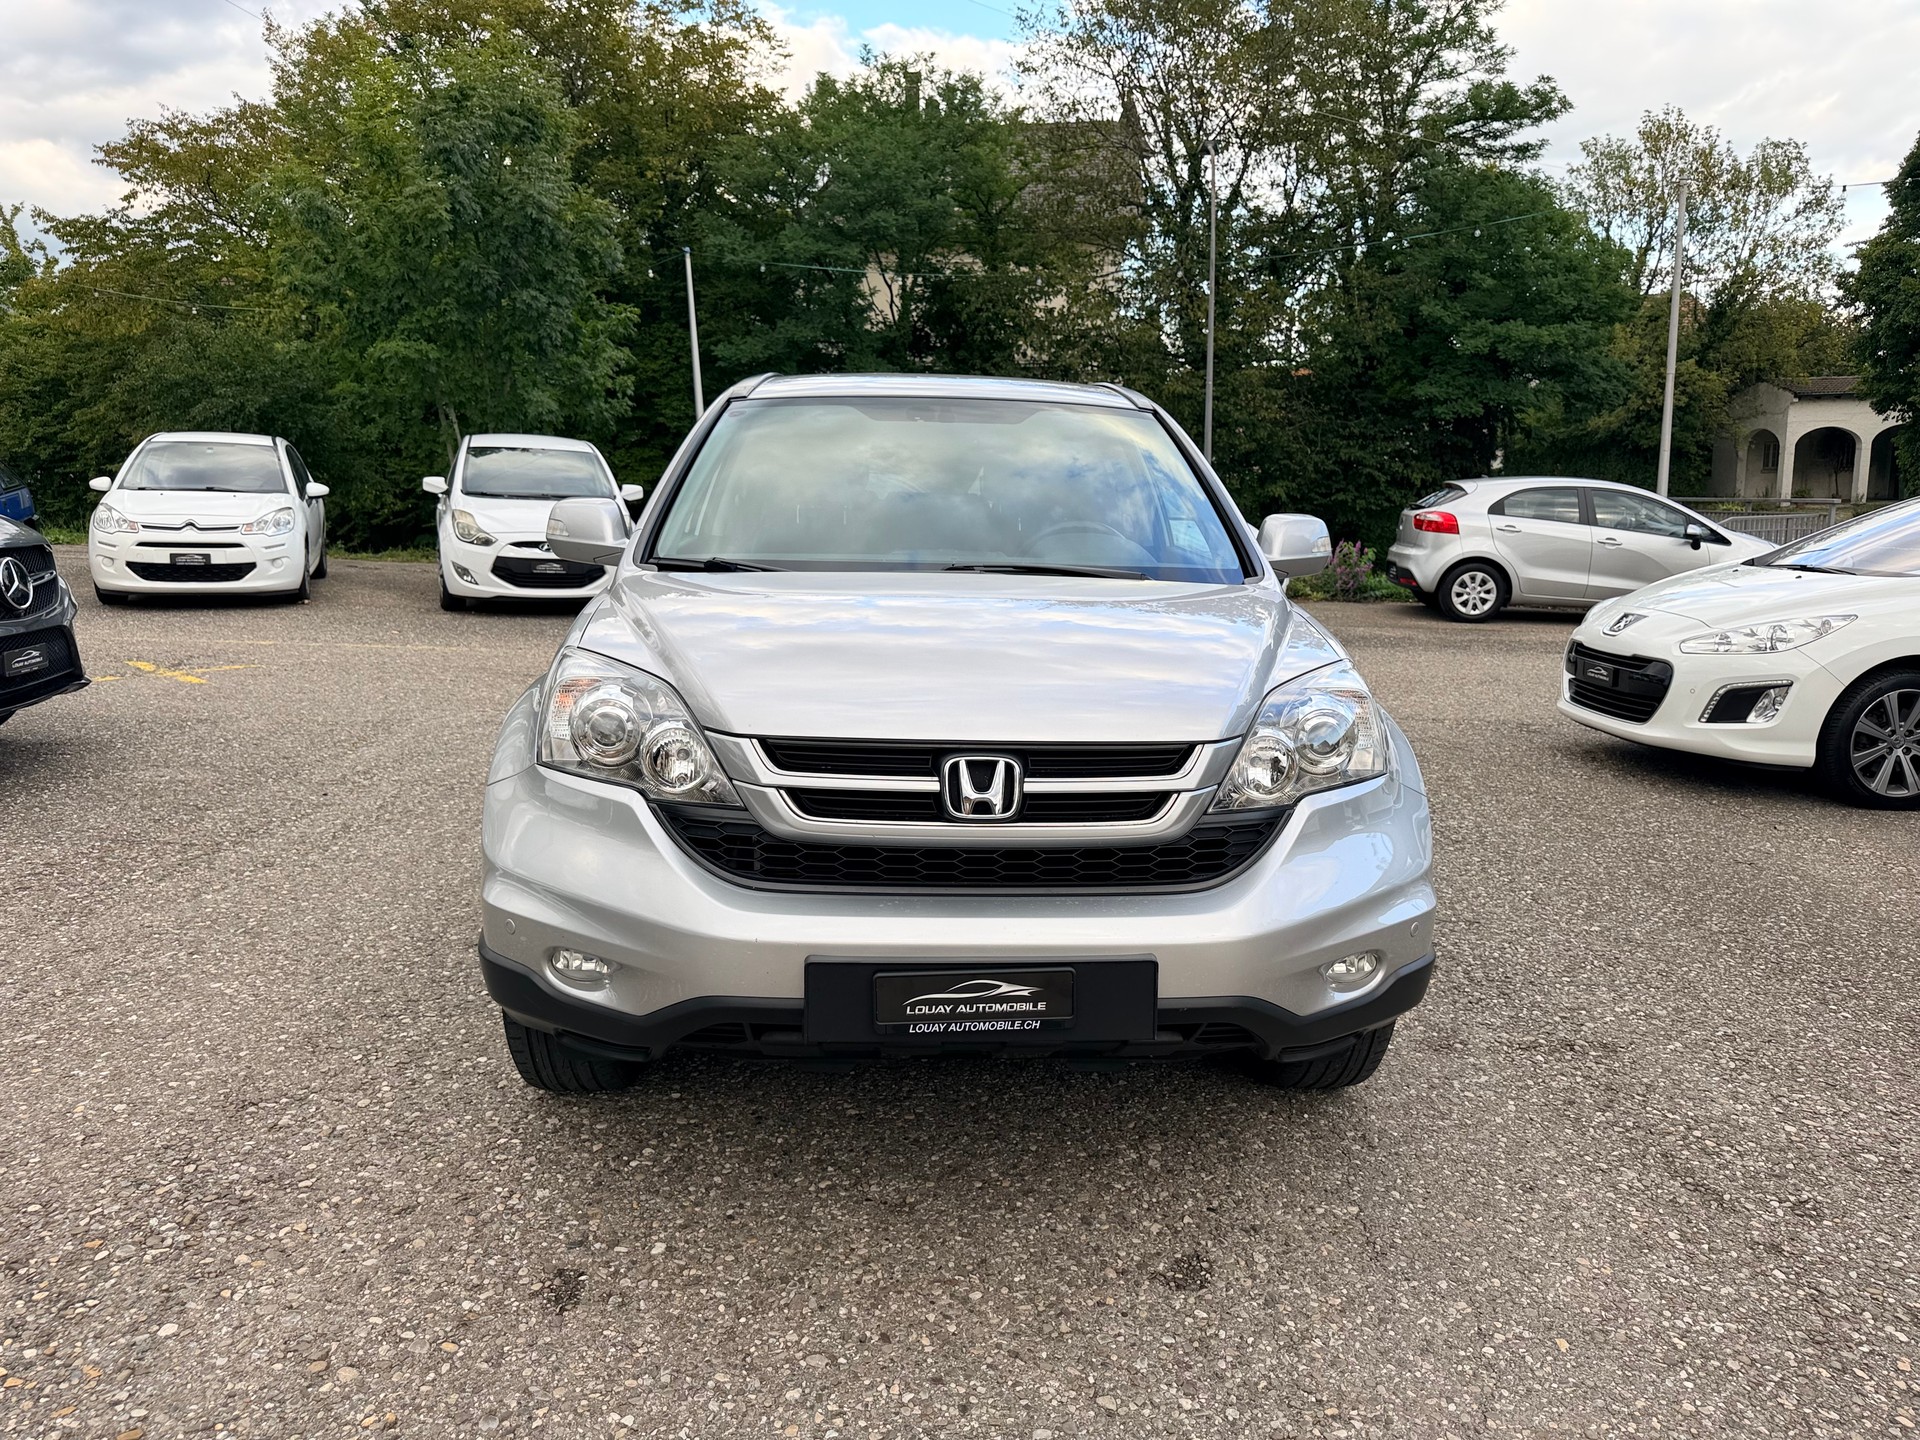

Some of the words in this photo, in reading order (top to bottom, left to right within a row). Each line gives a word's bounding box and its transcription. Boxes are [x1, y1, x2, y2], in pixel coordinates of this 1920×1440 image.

[906, 1005, 953, 1015] LOUAY
[955, 1002, 1047, 1013] AUTOMOBILE
[909, 1022, 946, 1033] LOUAY
[948, 1020, 1041, 1032] AUTOMOBILE.CH
